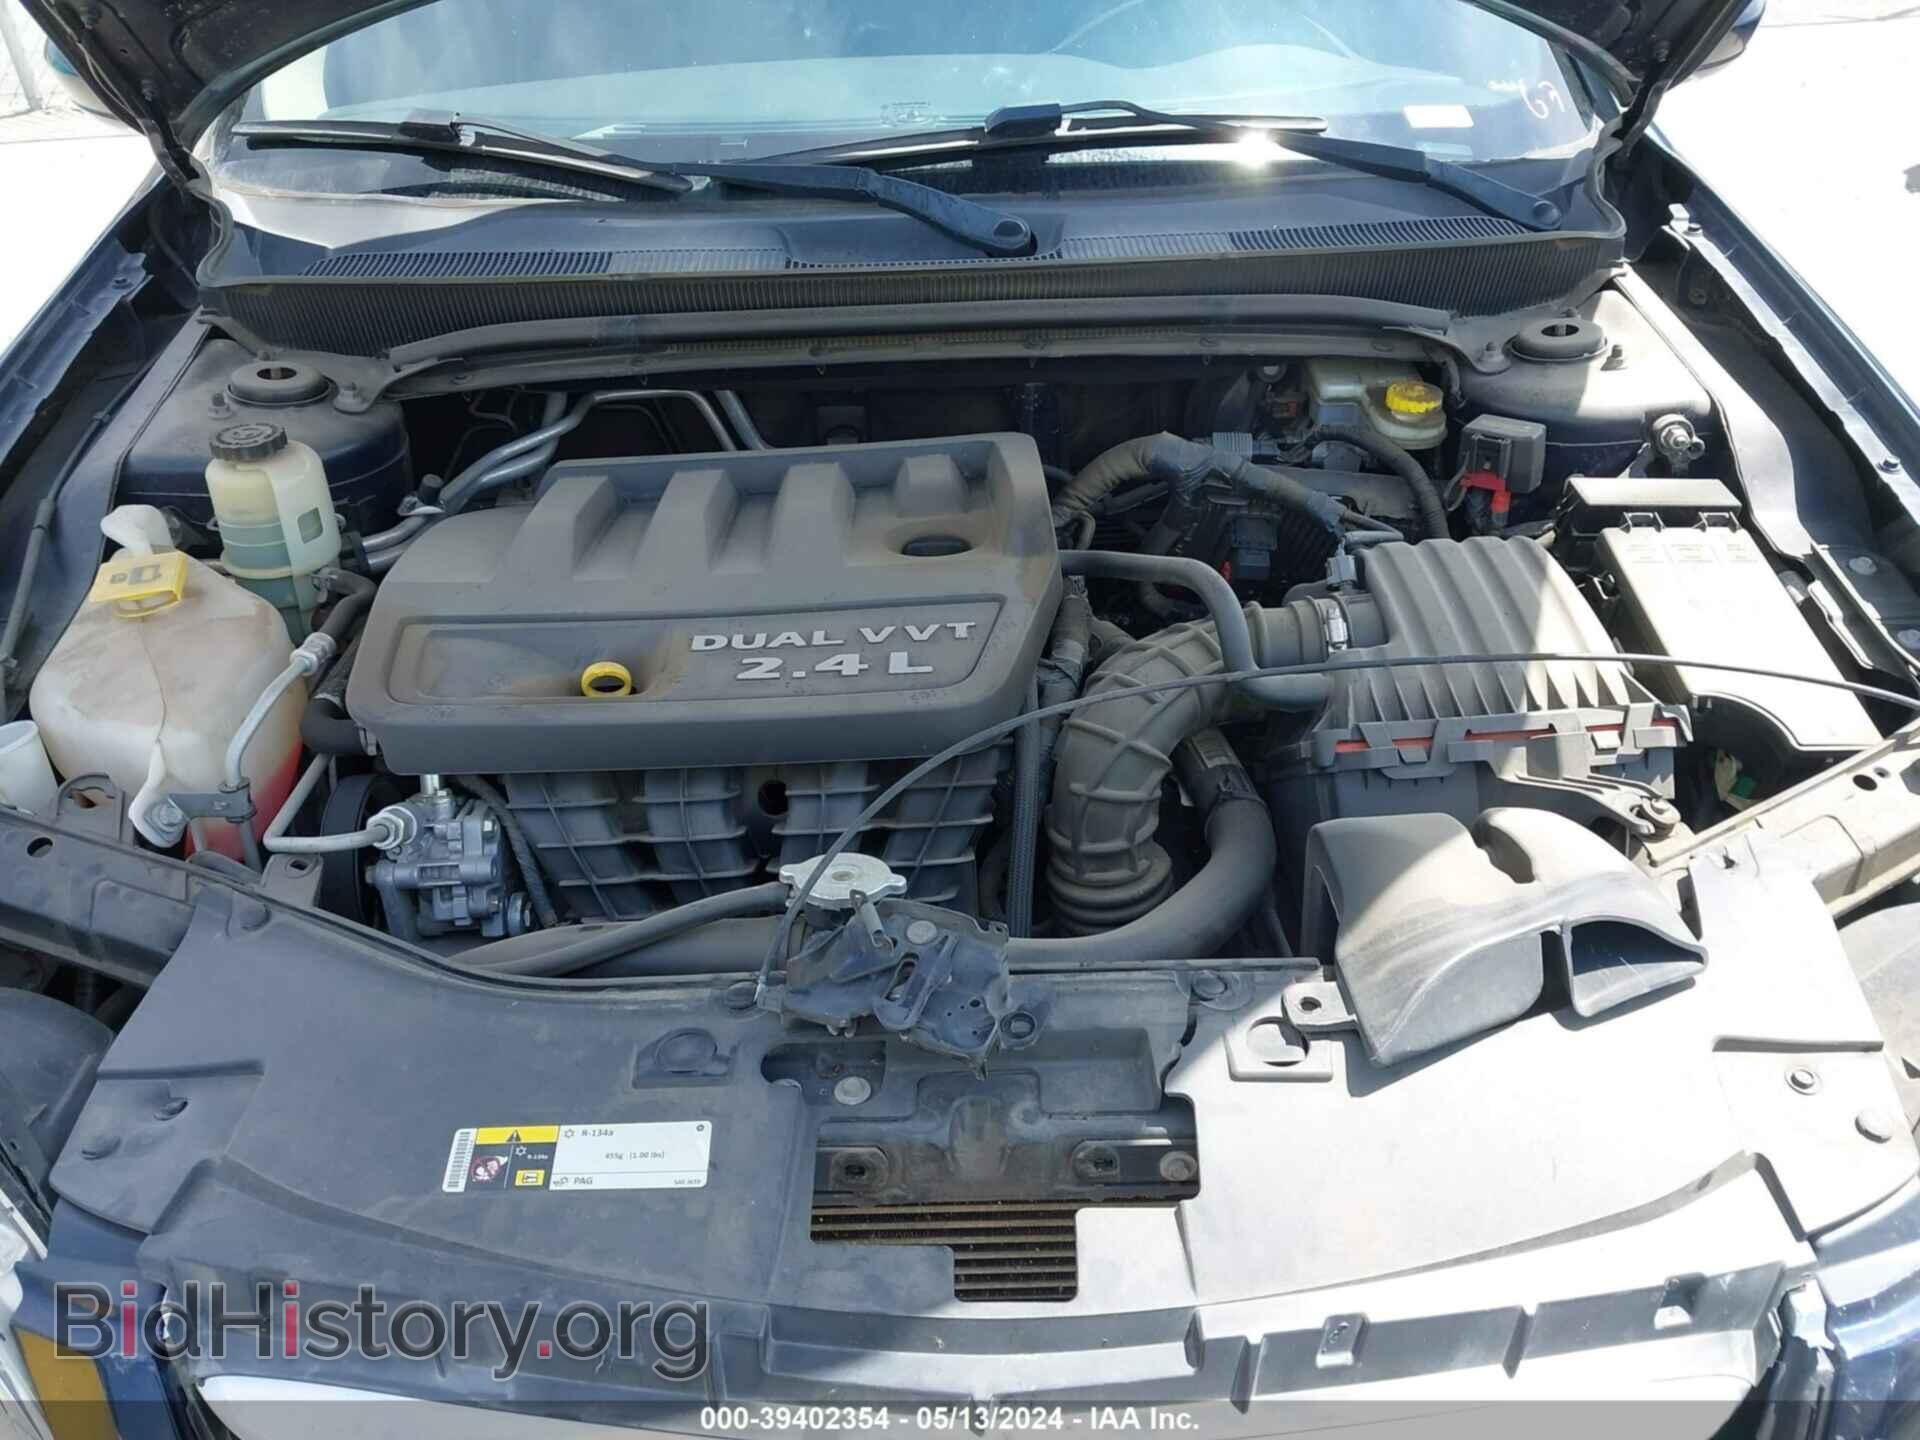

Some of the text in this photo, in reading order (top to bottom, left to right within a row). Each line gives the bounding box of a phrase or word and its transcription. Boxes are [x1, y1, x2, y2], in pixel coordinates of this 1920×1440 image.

[691, 622, 977, 651] DUAL VVT
[736, 650, 933, 681] 2.4 L
[581, 1129, 614, 1137] R-134a
[574, 1177, 593, 1185] PAG
